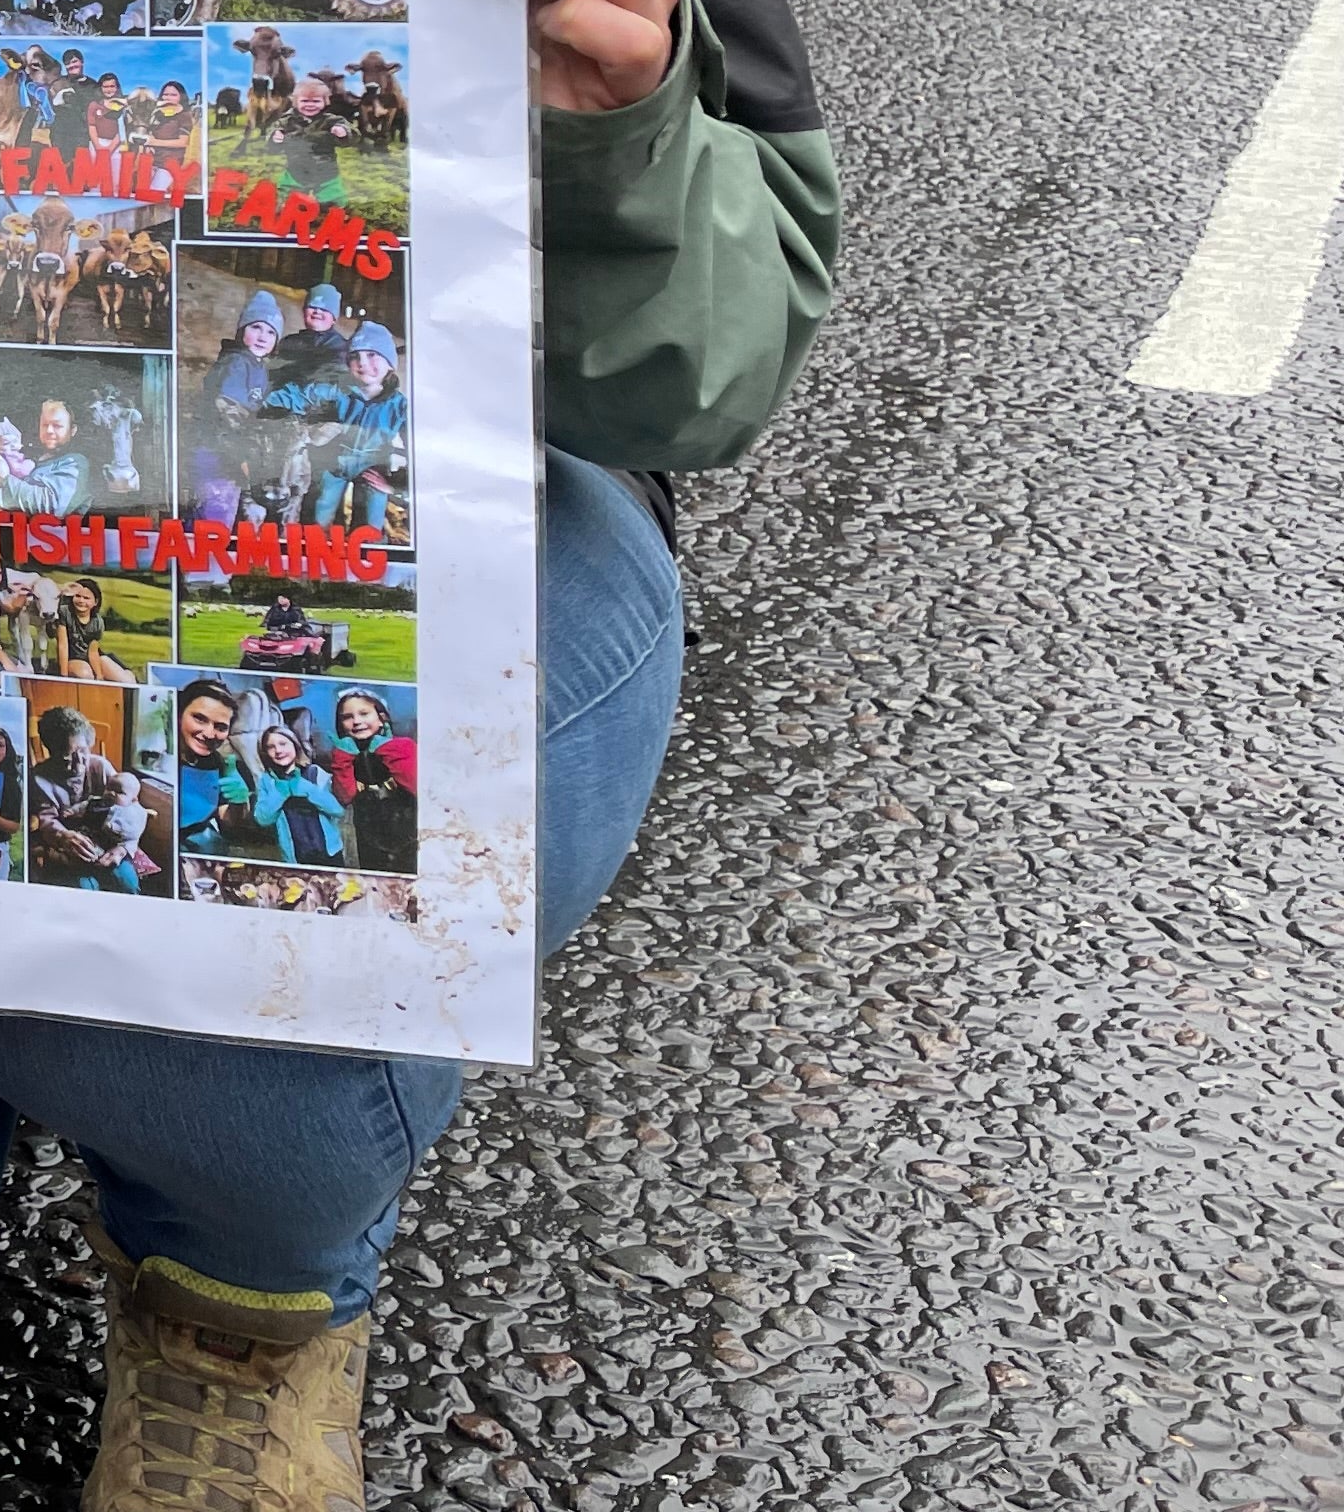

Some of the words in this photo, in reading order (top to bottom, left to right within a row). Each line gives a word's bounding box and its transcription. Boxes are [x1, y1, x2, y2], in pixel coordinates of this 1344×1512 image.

[0, 146, 203, 208] FAMILY
[207, 169, 401, 281] FARMS
[117, 515, 388, 582] FARMING
